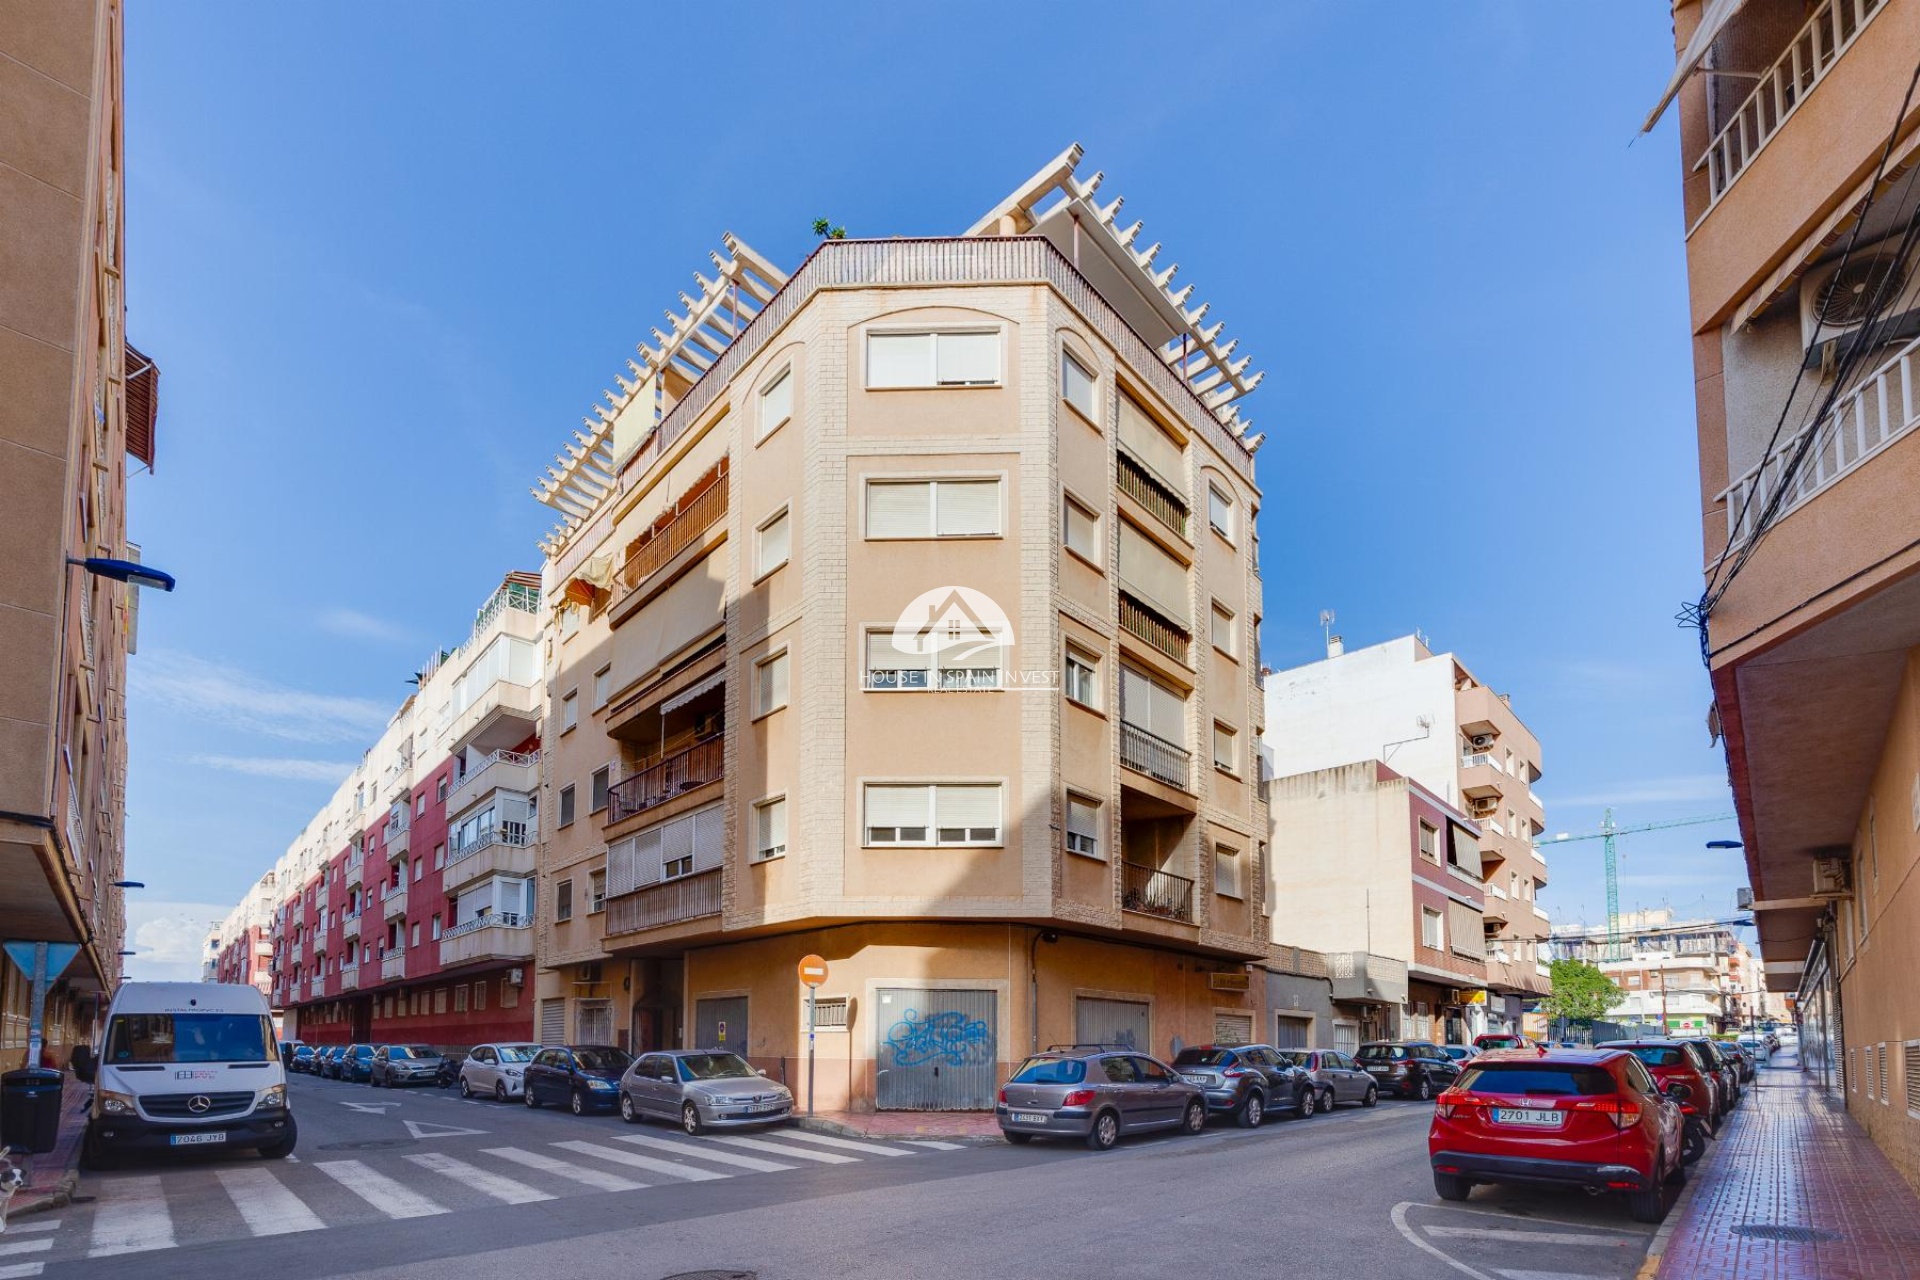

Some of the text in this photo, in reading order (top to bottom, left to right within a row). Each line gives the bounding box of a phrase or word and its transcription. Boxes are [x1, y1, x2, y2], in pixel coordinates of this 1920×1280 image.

[1500, 1109, 1560, 1122] 2701 JLB
[176, 1135, 203, 1144] 7046
